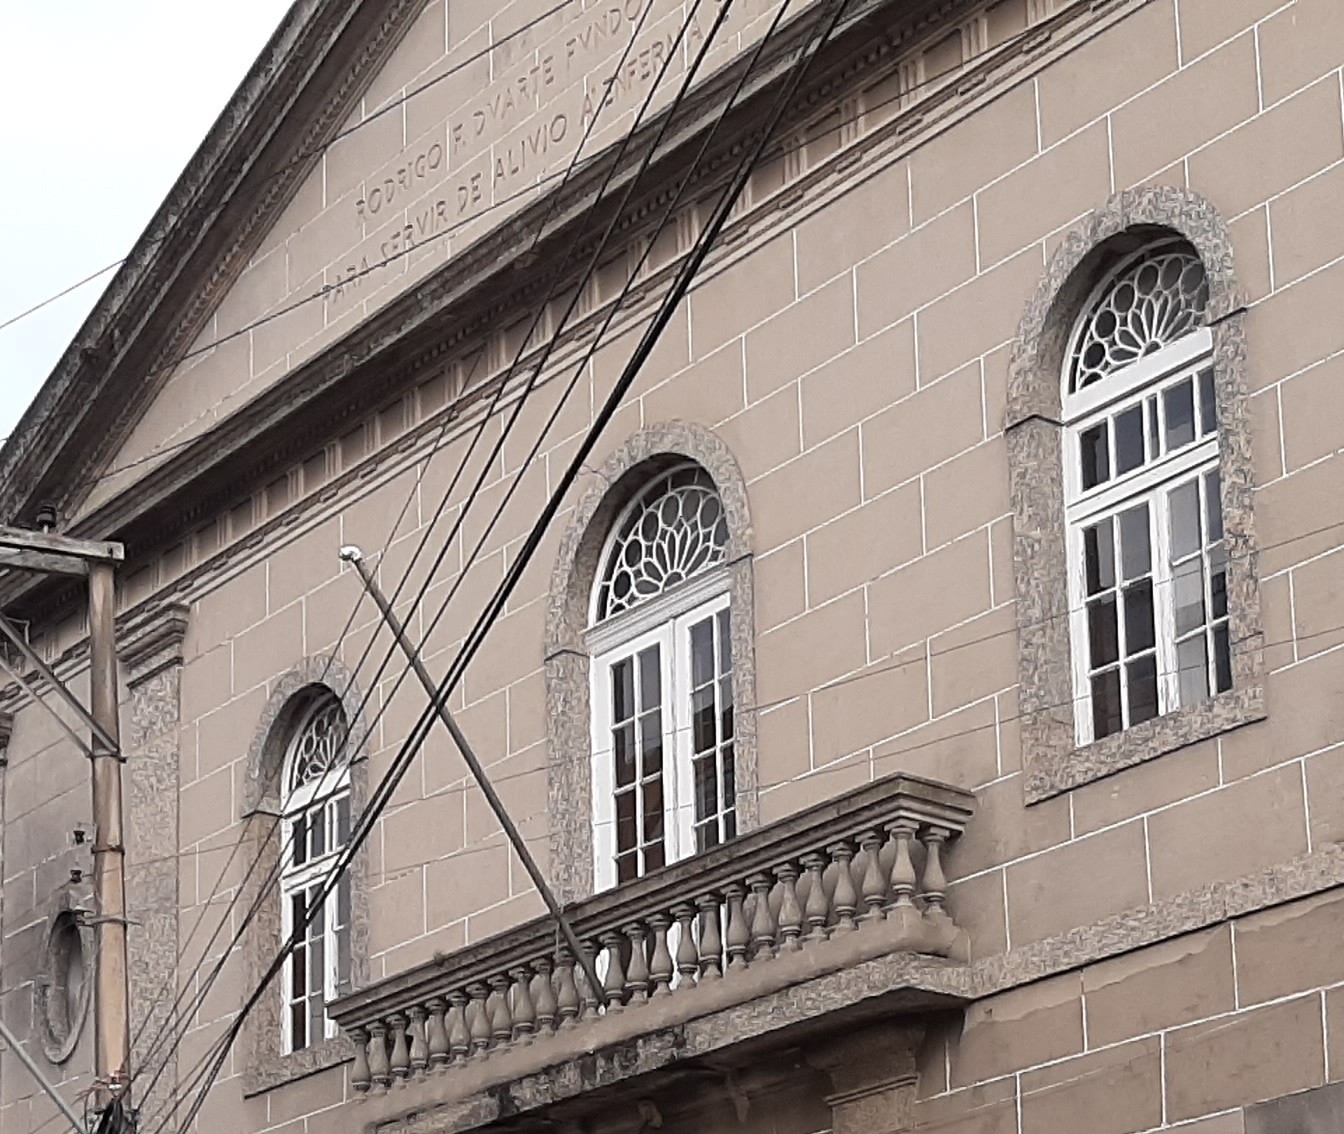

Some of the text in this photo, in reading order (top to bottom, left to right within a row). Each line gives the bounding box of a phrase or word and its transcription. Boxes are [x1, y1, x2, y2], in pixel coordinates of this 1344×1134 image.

[355, 143, 443, 227] RODRIGO
[456, 172, 482, 214] DE
[493, 113, 568, 189] ALIVIO
